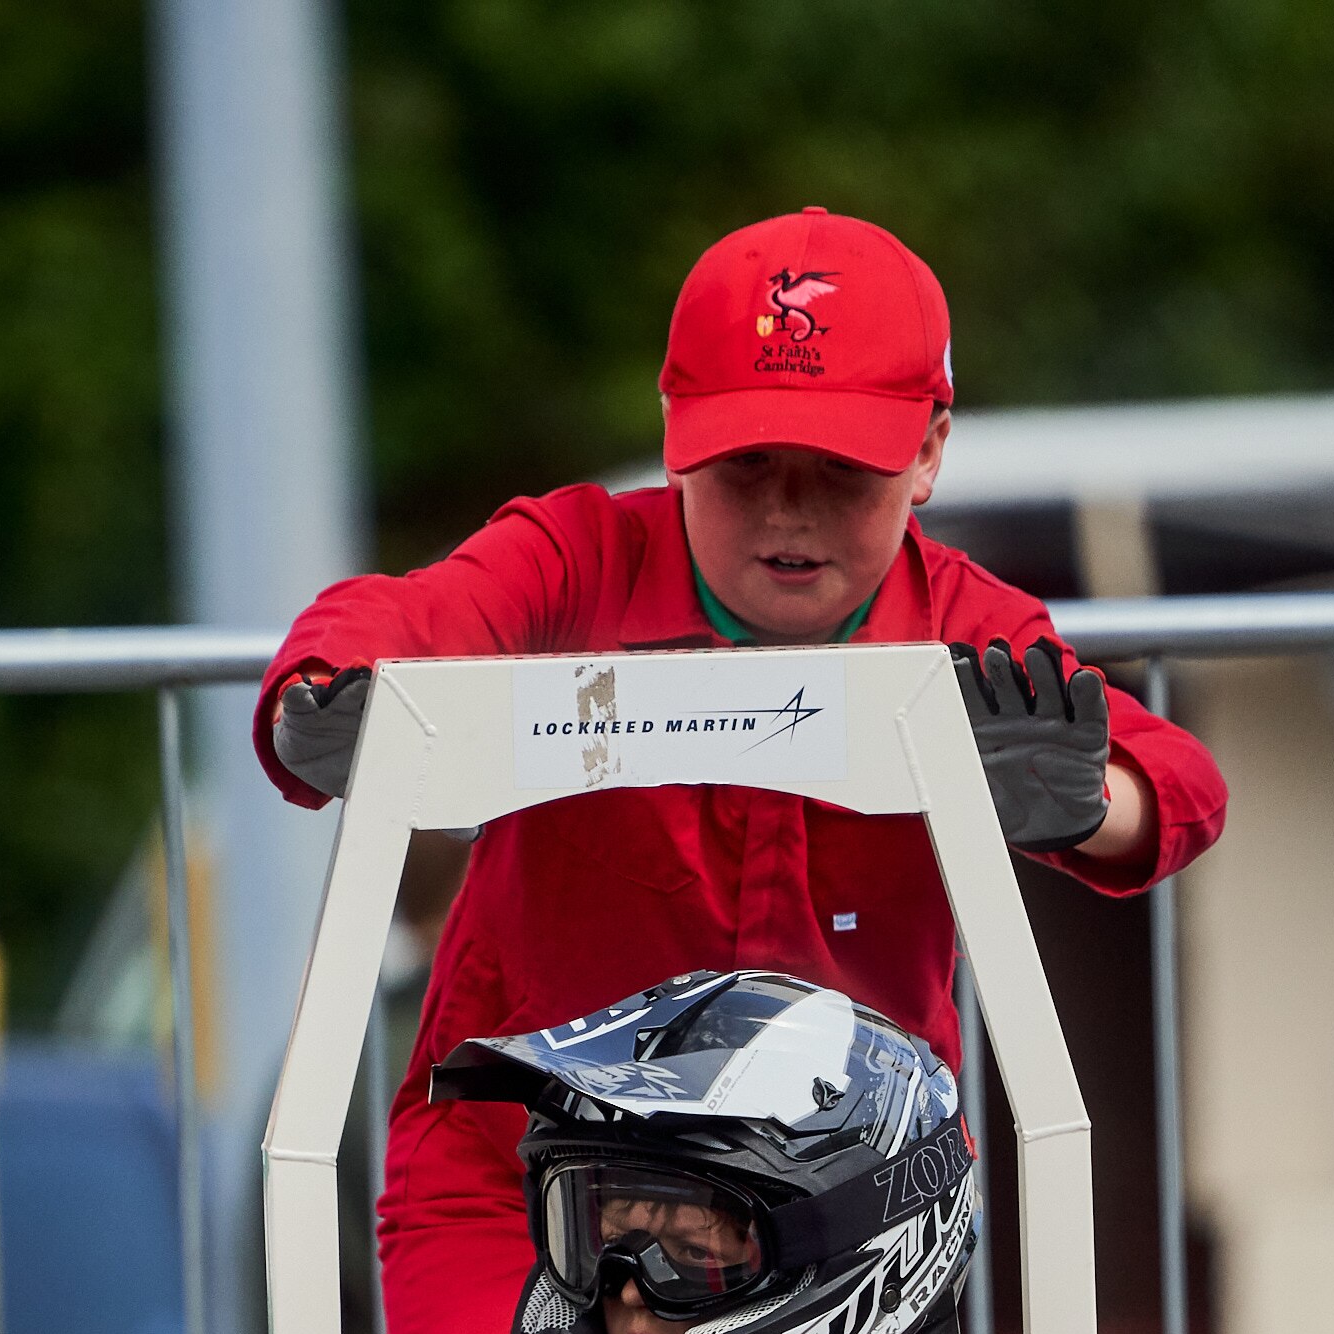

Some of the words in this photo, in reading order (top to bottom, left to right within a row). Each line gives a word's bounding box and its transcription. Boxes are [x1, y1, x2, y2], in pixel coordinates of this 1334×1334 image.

[762, 344, 774, 358] St
[777, 344, 821, 361] Faith's
[753, 359, 826, 378] Cambridge
[533, 720, 654, 736] LOCKHEED
[666, 717, 756, 733] MARTIN
[873, 1127, 969, 1223] ZOR
